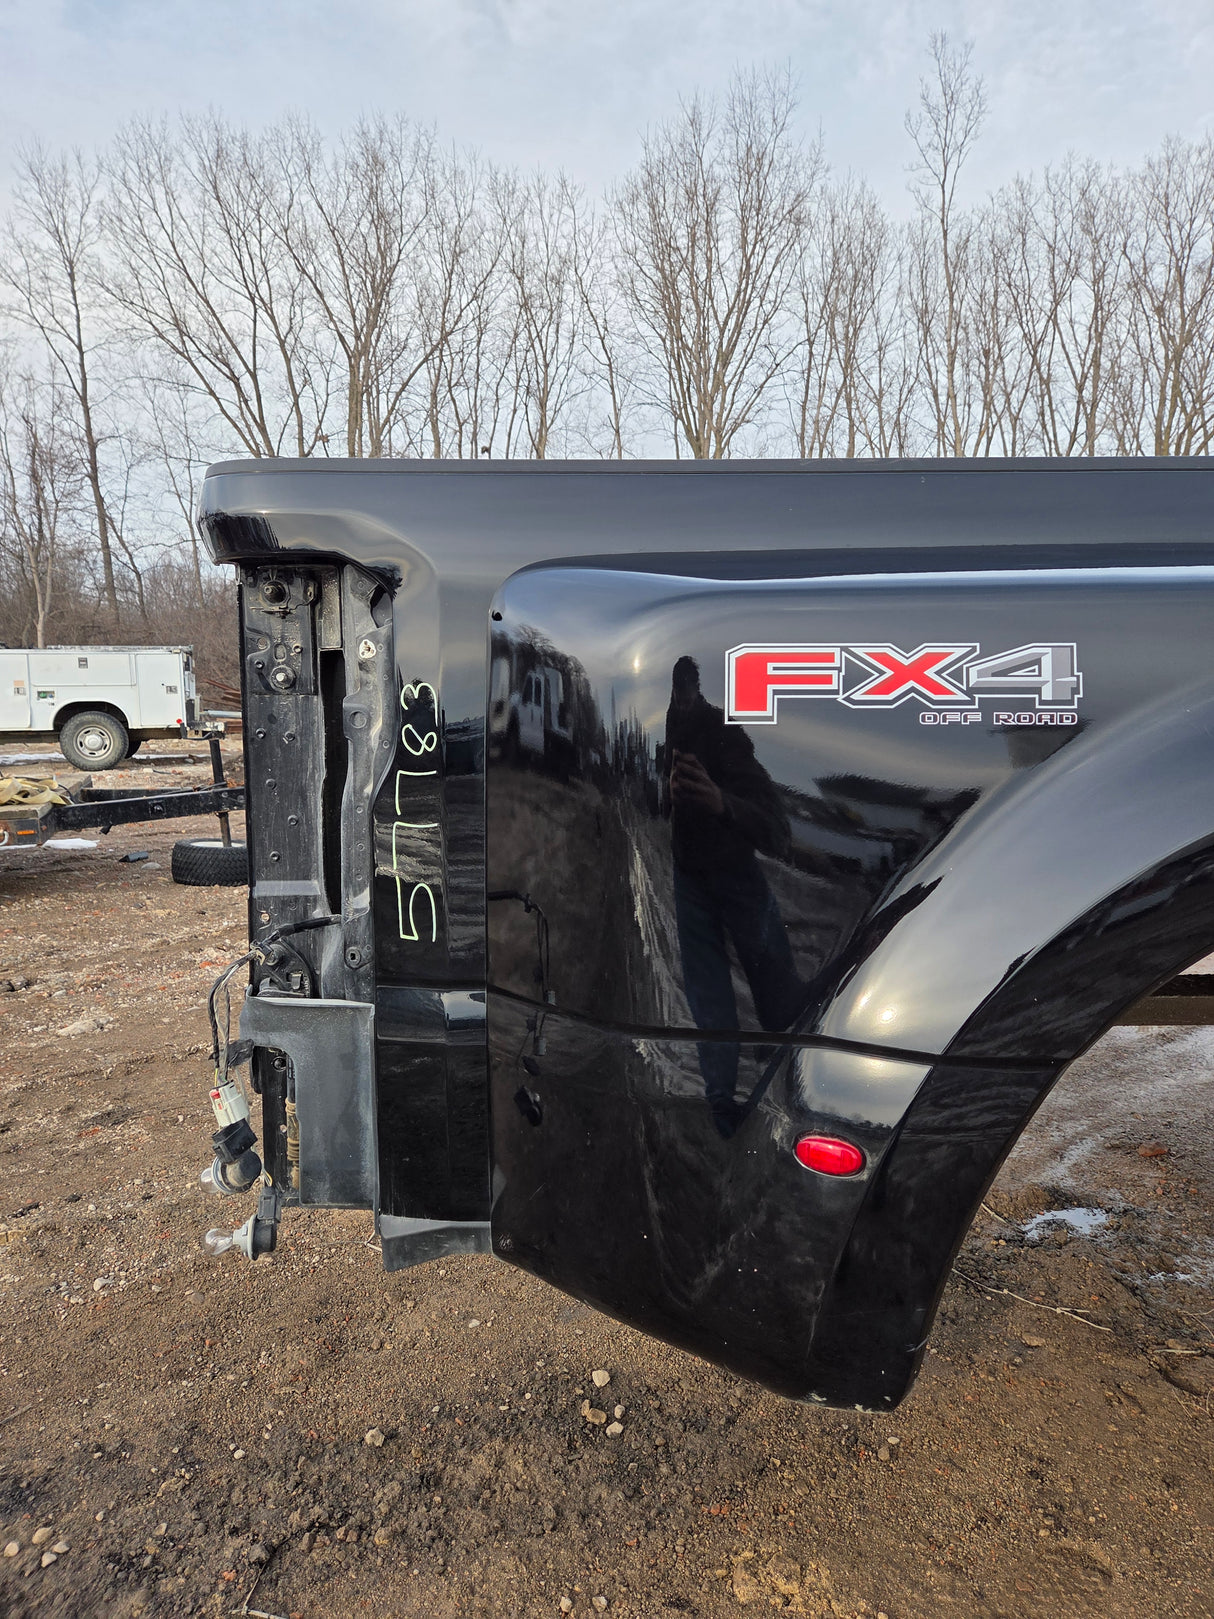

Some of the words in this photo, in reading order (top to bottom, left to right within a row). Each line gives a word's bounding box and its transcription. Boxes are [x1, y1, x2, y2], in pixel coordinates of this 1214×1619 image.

[724, 643, 1083, 725] FX4
[919, 712, 982, 726] OFF
[993, 712, 1078, 726] ROAD
[392, 682, 440, 943] 57783
